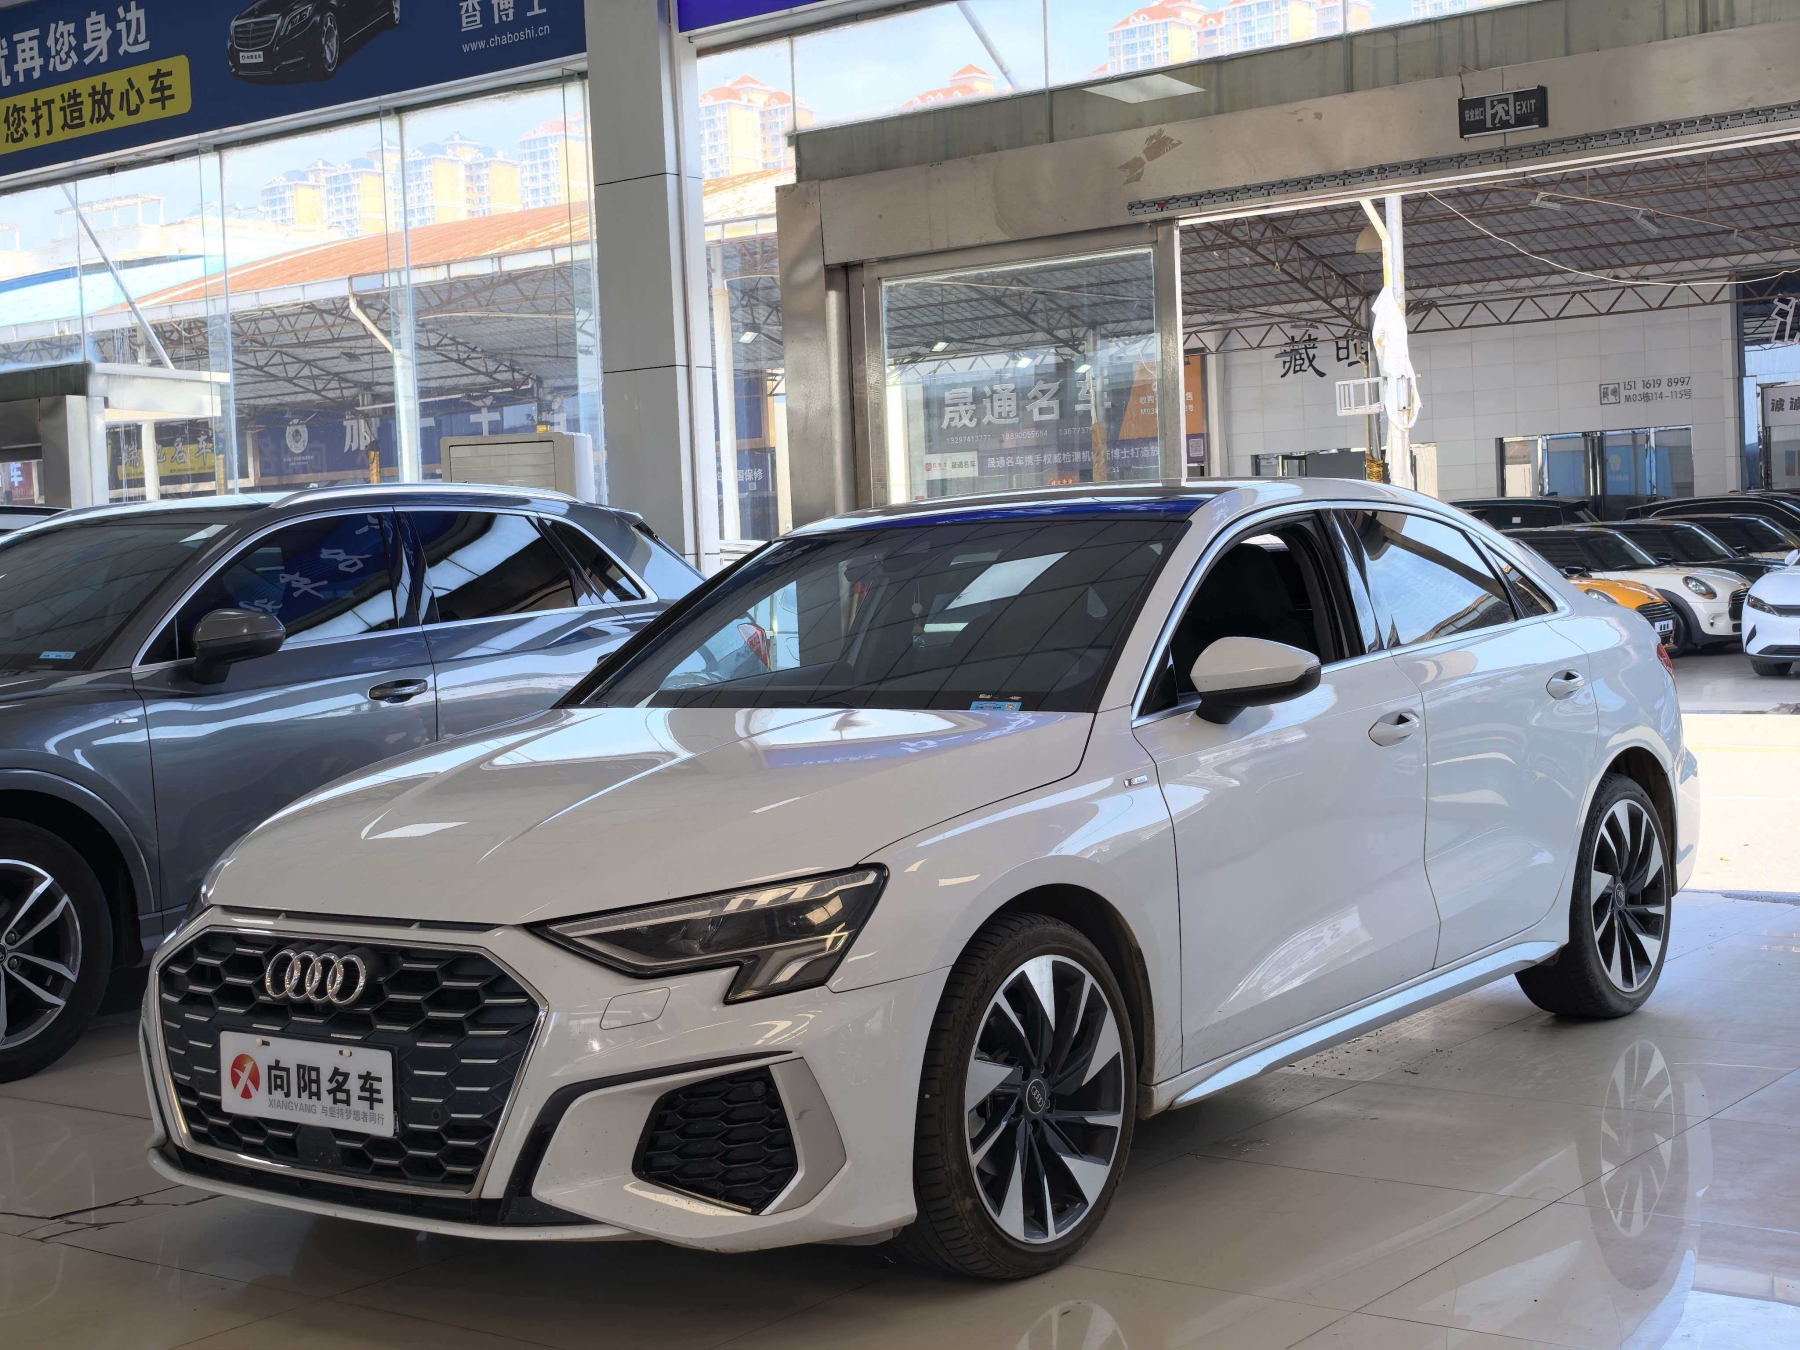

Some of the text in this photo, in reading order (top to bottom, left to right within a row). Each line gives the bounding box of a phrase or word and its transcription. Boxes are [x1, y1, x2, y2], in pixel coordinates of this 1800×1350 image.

[462, 25, 550, 52] www.chaboshi.cn
[4, 68, 174, 143] 您打造放心车
[1515, 99, 1536, 115] EXIT
[1622, 376, 1691, 391] 151 1619 8997
[267, 1059, 384, 1110] 向阳名车
[268, 1098, 385, 1126] XIANGYANG 与坚持梦想者同行
